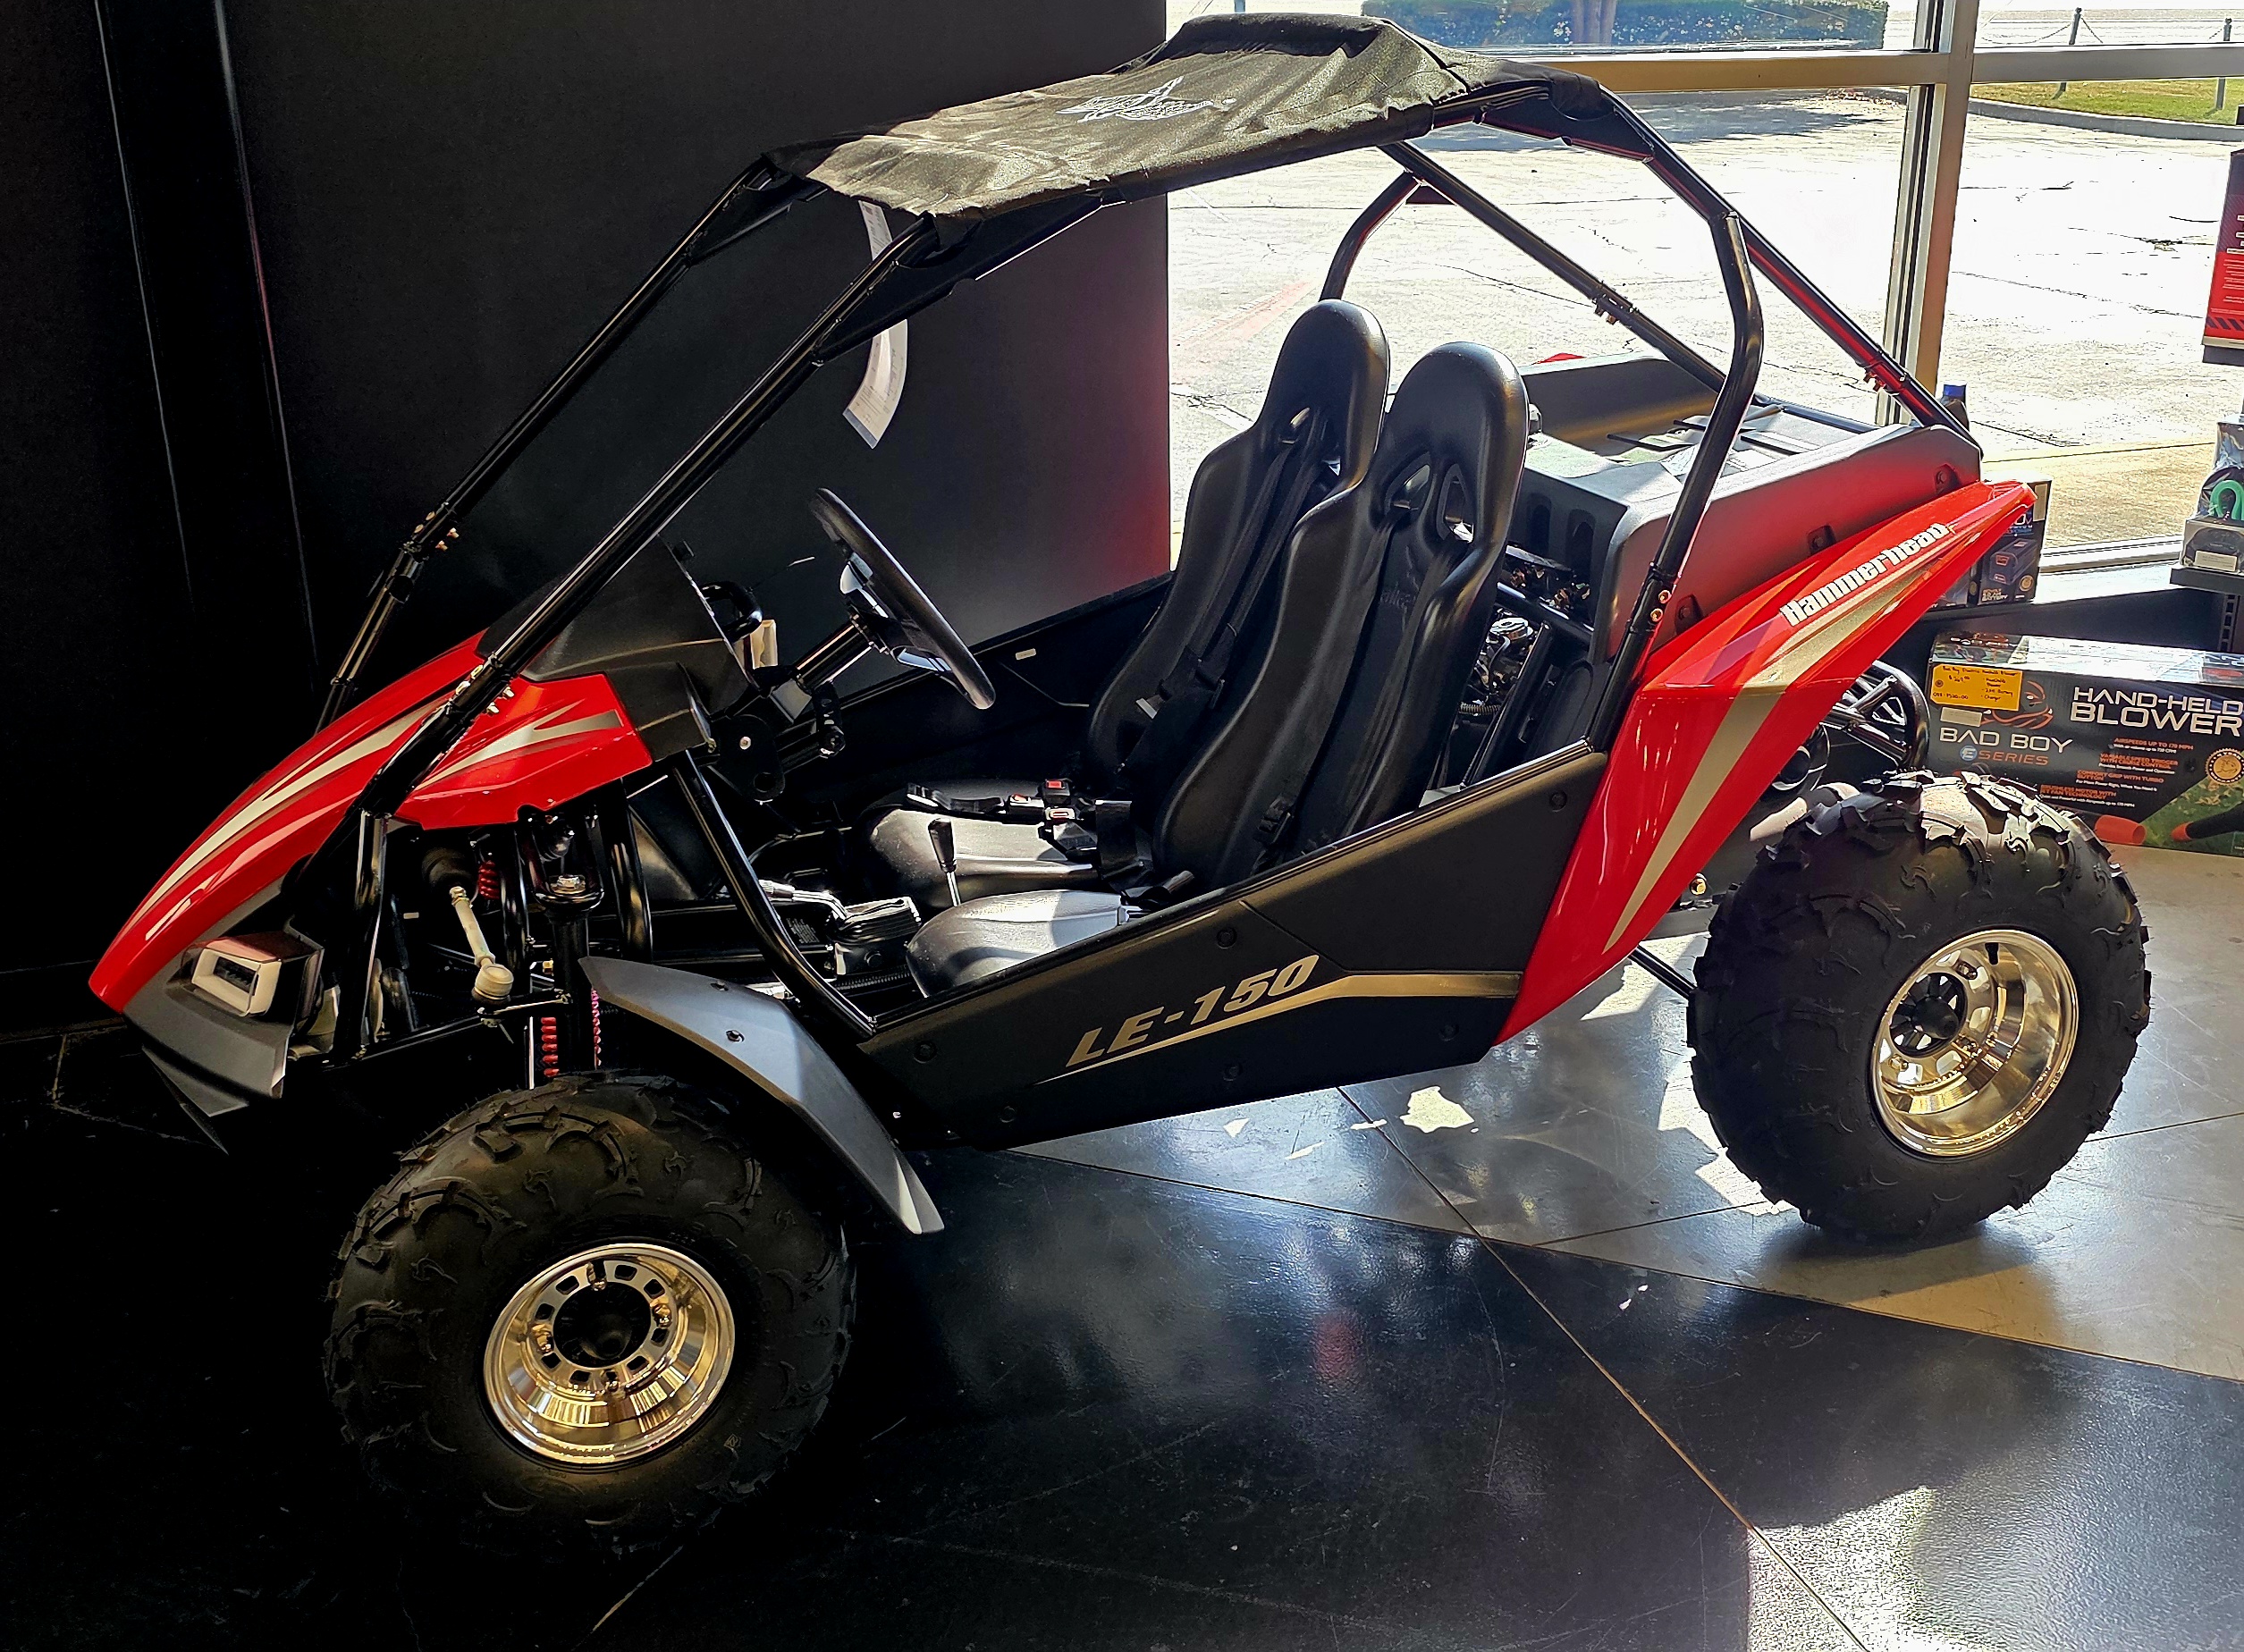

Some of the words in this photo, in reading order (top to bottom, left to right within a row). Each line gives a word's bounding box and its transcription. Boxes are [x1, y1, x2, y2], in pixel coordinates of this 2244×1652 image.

[2073, 687, 2243, 715] HAND-HELD
[2071, 702, 2242, 738] BLOWER
[1939, 727, 2000, 746] BAD
[2010, 733, 2073, 754] BOY
[1978, 750, 2049, 766] SERIES
[1066, 955, 1320, 1067] LE-150
